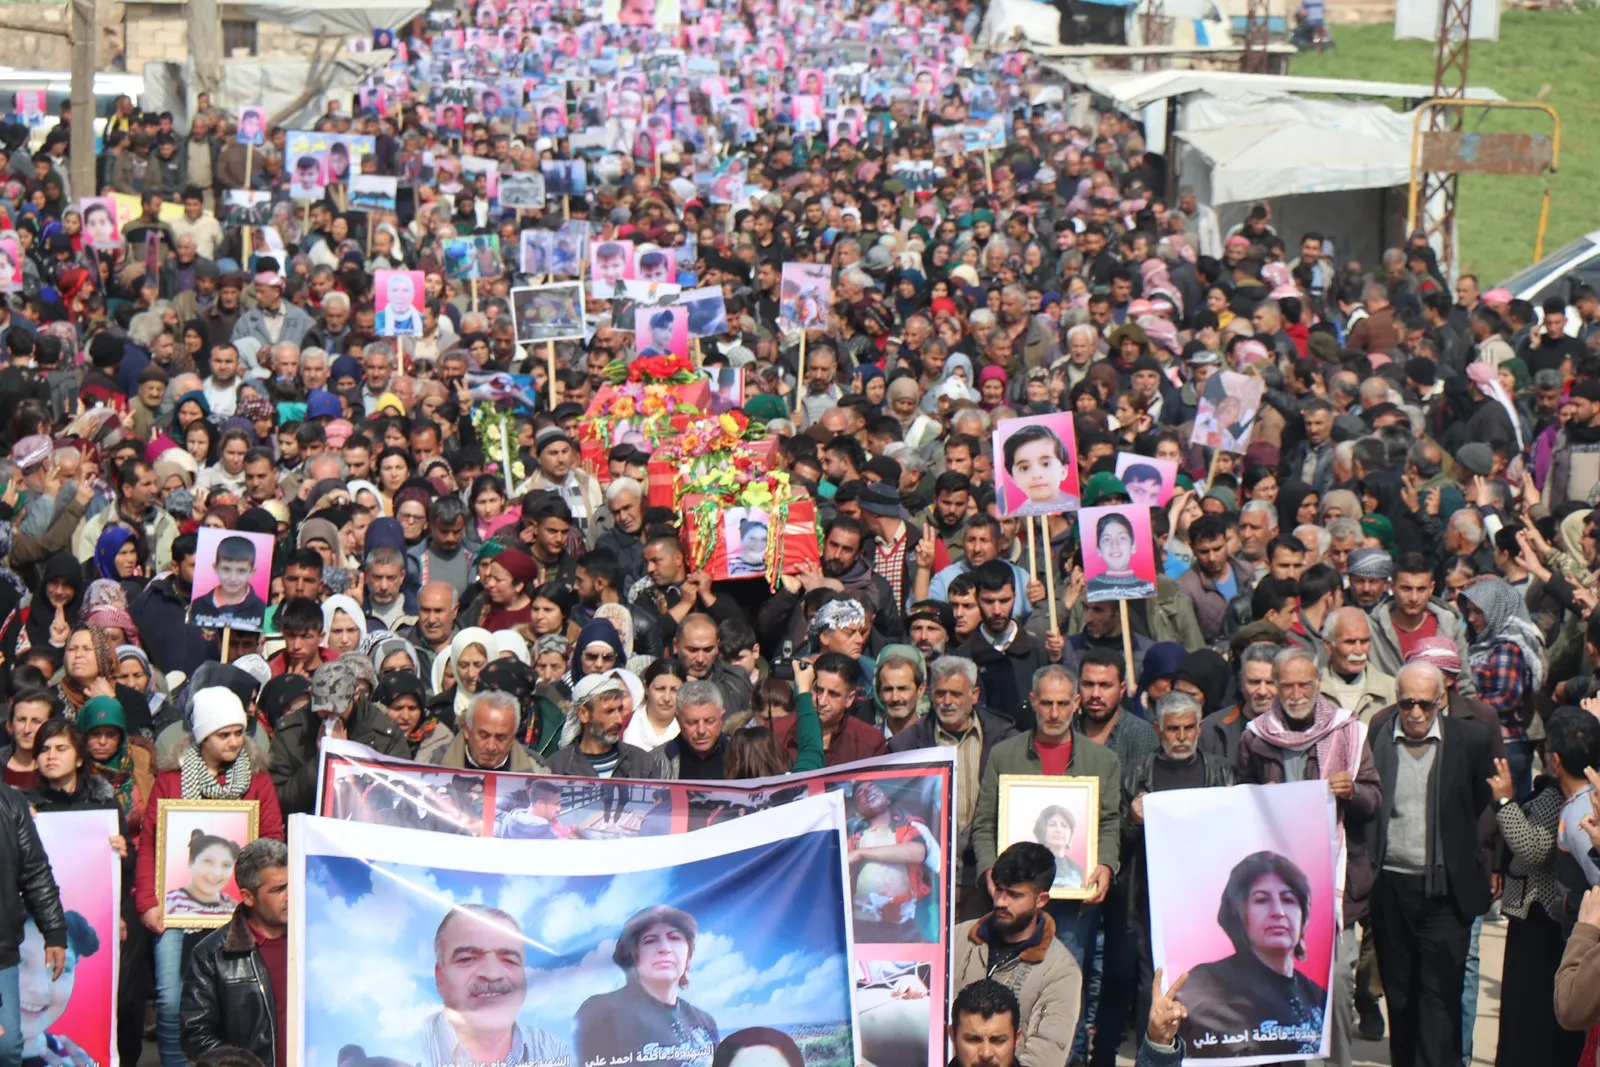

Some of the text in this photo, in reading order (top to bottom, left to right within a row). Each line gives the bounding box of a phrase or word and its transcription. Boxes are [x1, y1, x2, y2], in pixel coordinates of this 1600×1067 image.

[1193, 1032, 1218, 1049] علي
[1221, 1030, 1248, 1044] احمد
[1253, 1029, 1288, 1041] فاطمة
[609, 1052, 632, 1065] احمد
[636, 1050, 667, 1062] فاطمة
